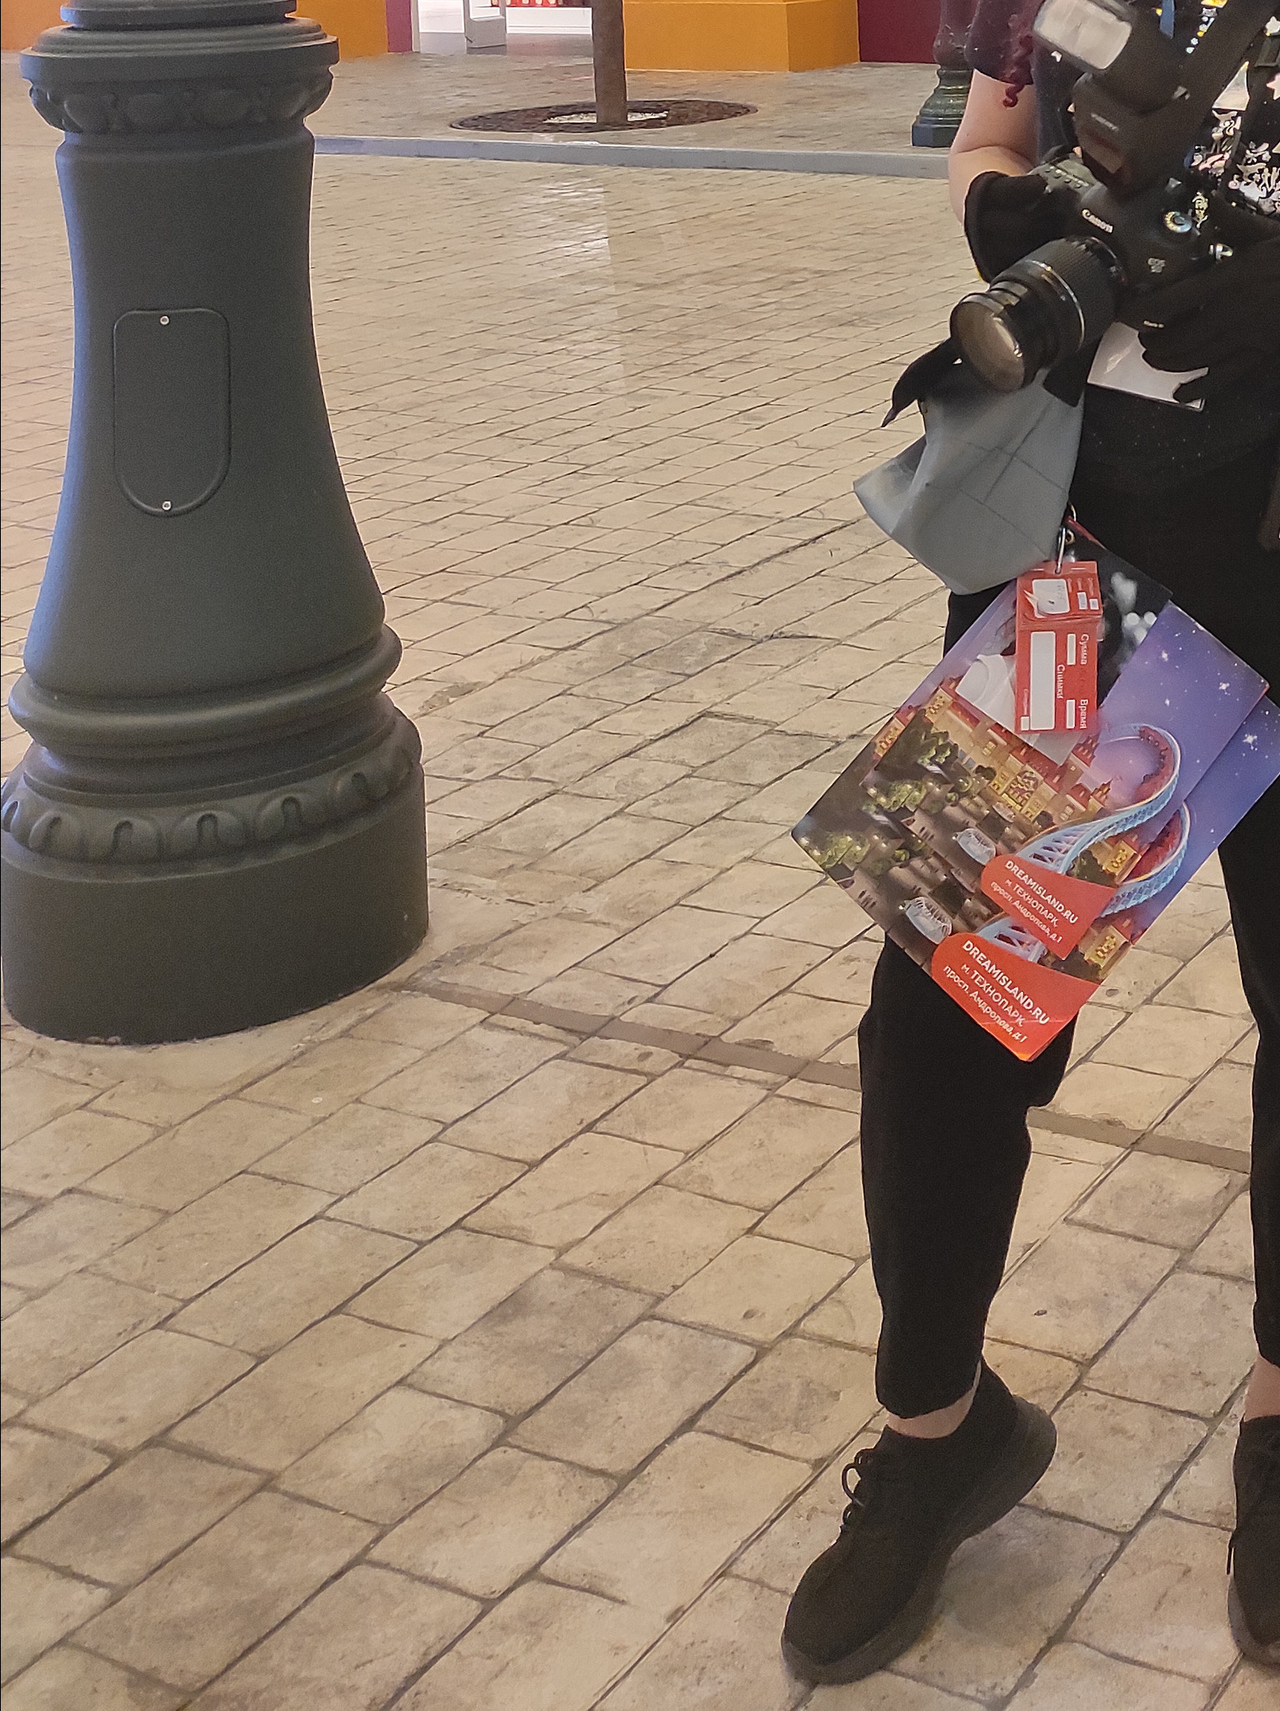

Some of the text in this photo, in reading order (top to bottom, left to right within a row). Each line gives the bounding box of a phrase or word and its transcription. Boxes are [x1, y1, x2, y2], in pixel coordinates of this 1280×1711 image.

[1082, 209, 1113, 233] Canon
[1079, 633, 1089, 665] Сумма
[1079, 699, 1088, 729] Время
[1005, 860, 1079, 924] DREAMISLAND.RU
[943, 965, 969, 994] просп.
[970, 990, 1013, 1035] Андропова,
[962, 940, 1050, 1025] DREAMISLAND.RU
